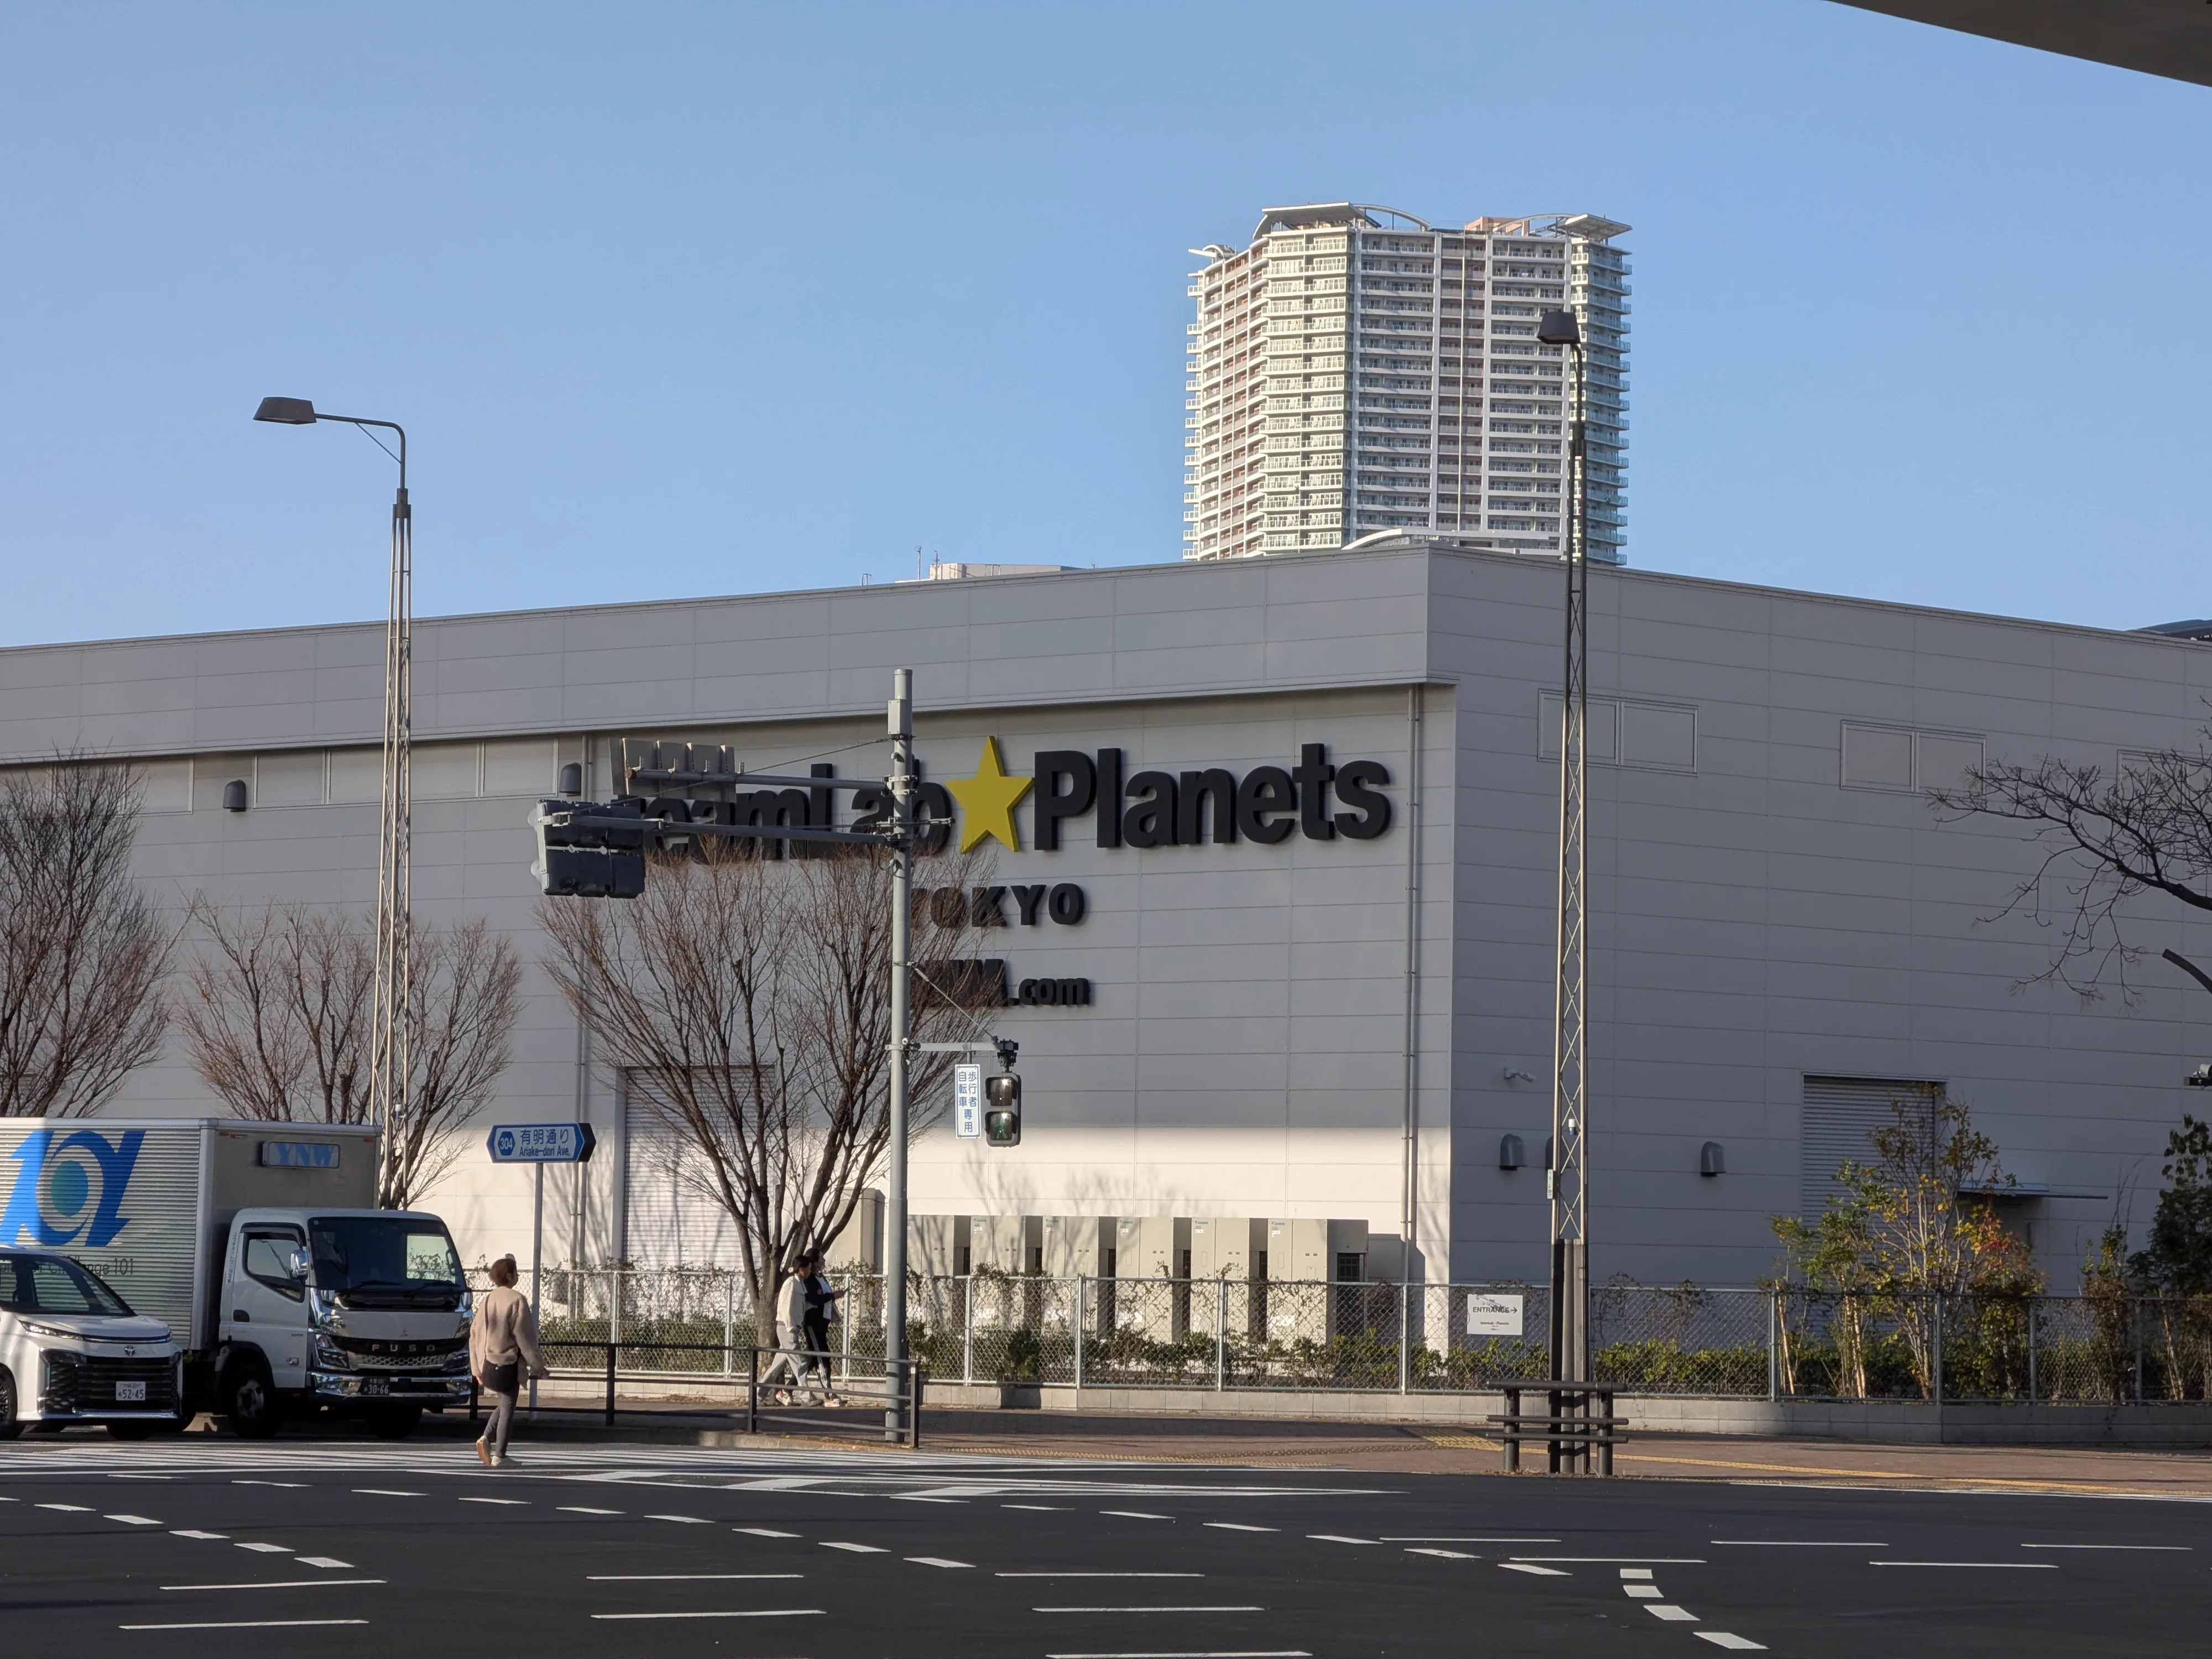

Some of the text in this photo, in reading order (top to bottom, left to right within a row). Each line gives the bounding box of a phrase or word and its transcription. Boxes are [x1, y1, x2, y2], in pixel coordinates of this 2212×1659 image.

[1034, 743, 1391, 851] Planets
[520, 1129, 569, 1145] 有明通り
[500, 1138, 513, 1150] 304
[519, 1145, 571, 1157] Ariake-dori Ave.
[372, 1344, 436, 1352] FUSO
